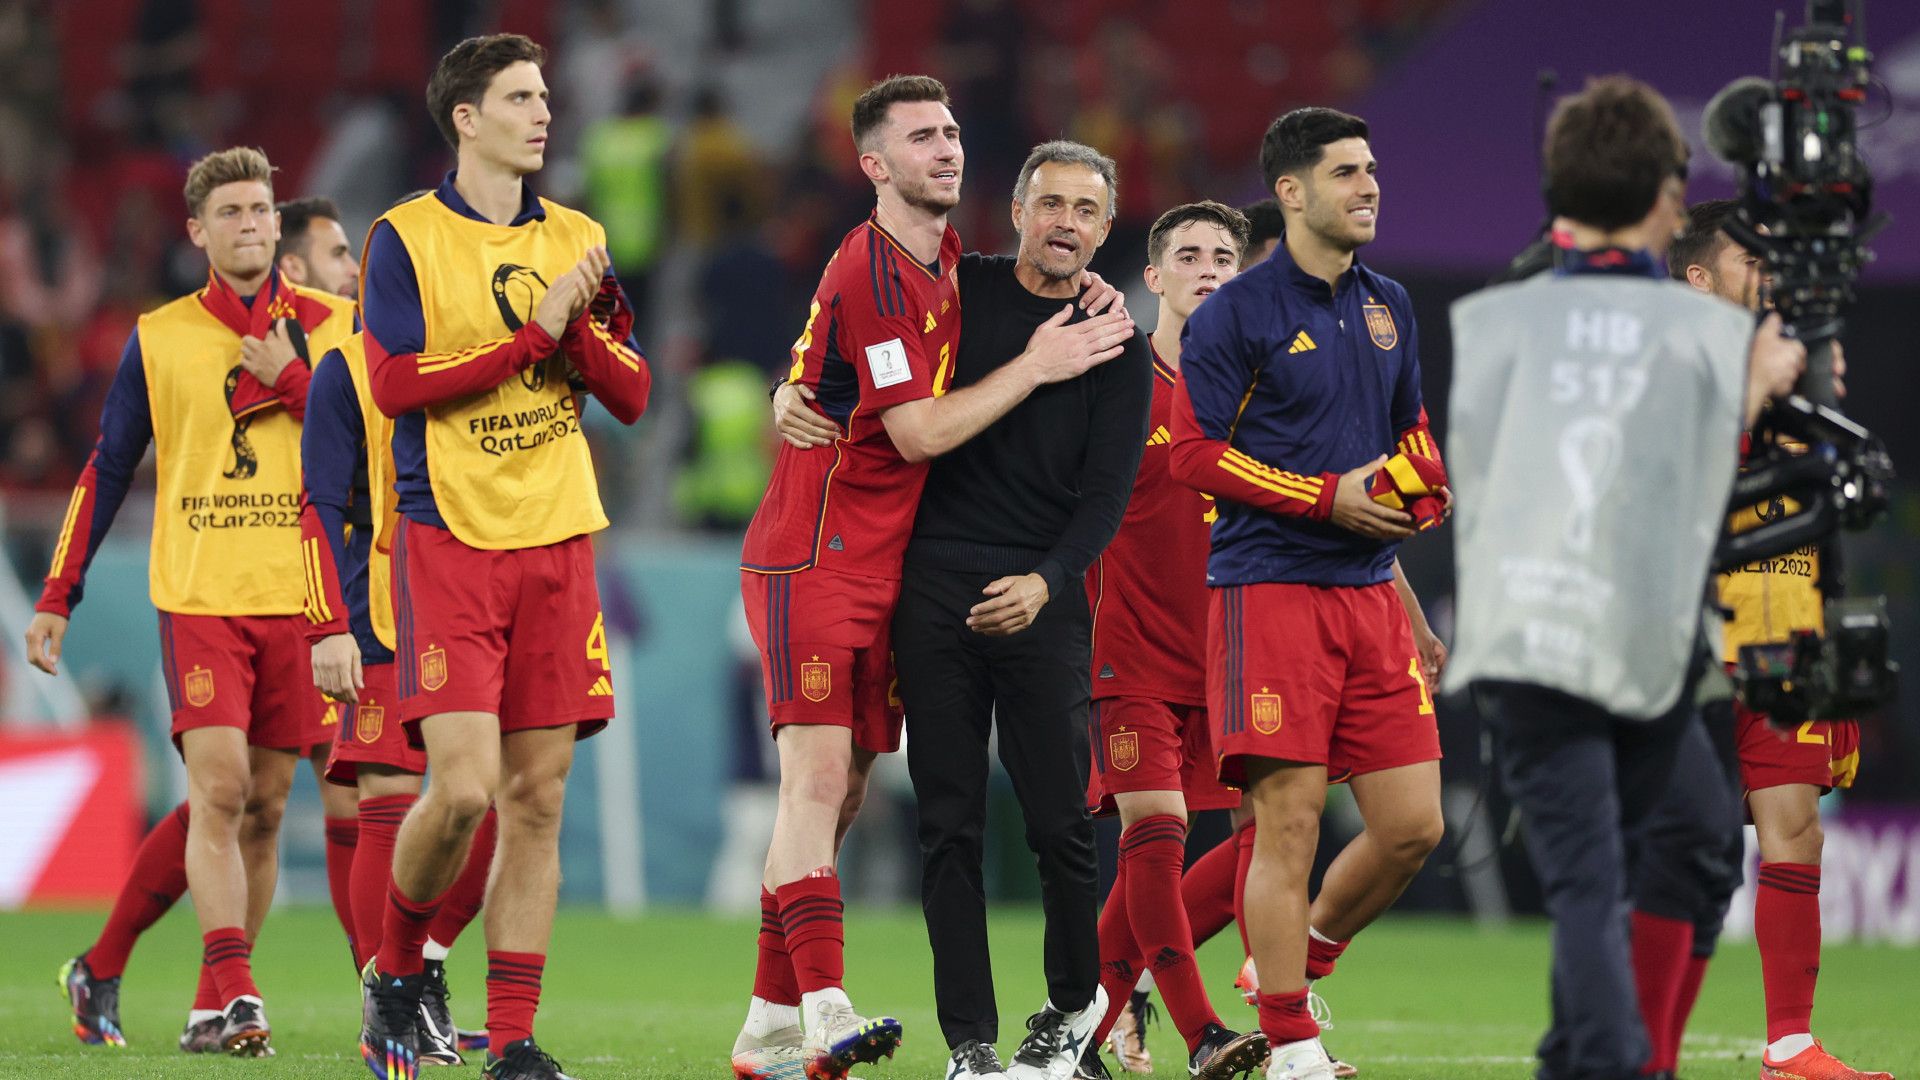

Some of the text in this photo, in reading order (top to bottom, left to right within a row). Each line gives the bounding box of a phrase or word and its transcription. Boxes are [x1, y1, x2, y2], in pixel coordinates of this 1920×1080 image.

[1566, 309, 1642, 354] HB
[469, 415, 512, 434] FIFA
[480, 415, 578, 457] Qatar202
[181, 493, 301, 511] FIFA WORLD CU
[586, 611, 611, 671] 4
